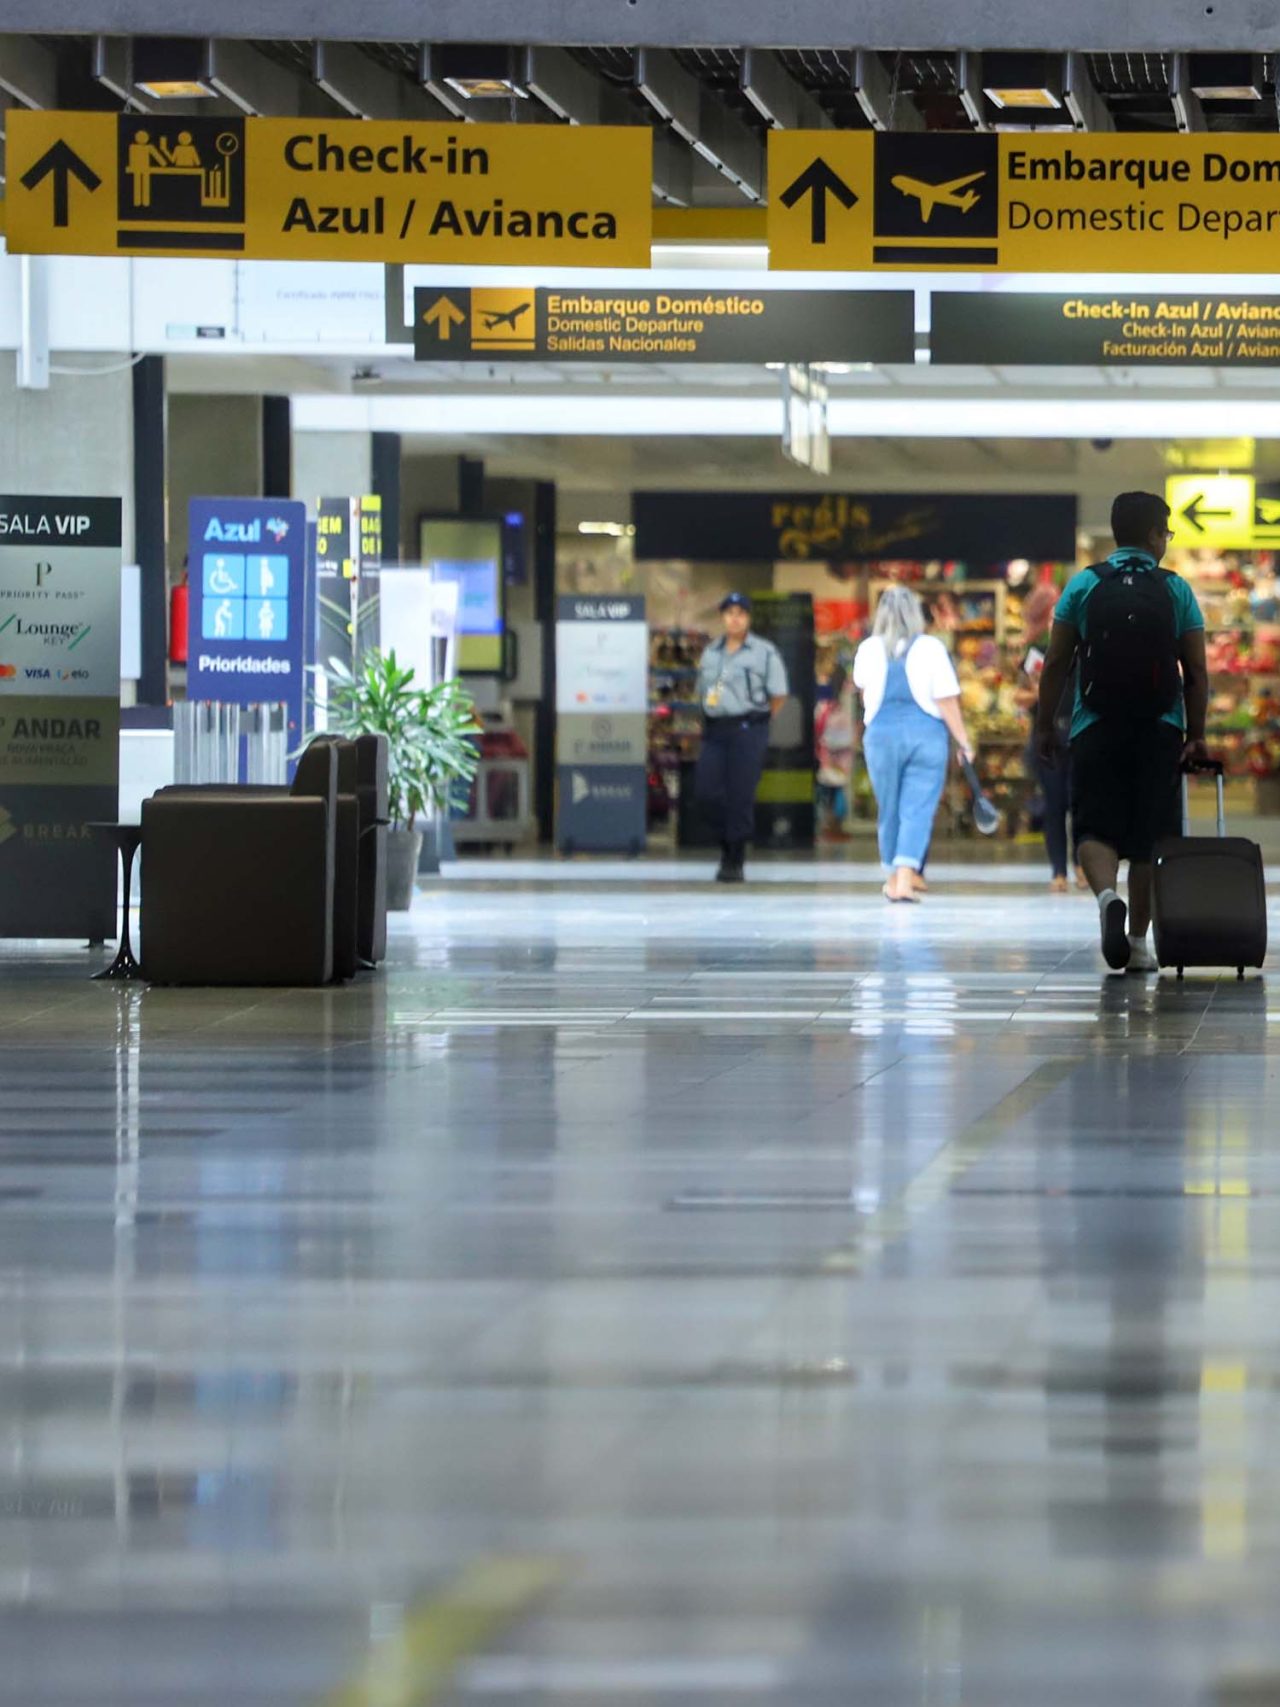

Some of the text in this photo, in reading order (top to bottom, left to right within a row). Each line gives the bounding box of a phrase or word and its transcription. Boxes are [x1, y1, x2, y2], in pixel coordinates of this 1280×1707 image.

[284, 134, 489, 175] Check-in
[1008, 150, 1190, 189] Embarque
[282, 197, 617, 240] Azul / Avianca
[1008, 201, 1164, 231] Domestic
[547, 295, 765, 317] Embarque Doméstico
[1154, 301, 1200, 320] Azul
[1203, 302, 1212, 322] /
[547, 316, 704, 336] Domestic Departure
[1190, 322, 1224, 339] Azul
[1225, 323, 1234, 340] /
[547, 336, 697, 353] Salidas Nacionales
[1103, 340, 1188, 358] Facturación
[1192, 341, 1224, 357] Azul
[1226, 342, 1235, 358] /
[0, 514, 91, 536] SALA VIP
[203, 516, 261, 543] Azul
[17, 619, 79, 639] Lounge
[25, 668, 51, 679] VISA
[199, 655, 291, 675] Prioridades
[13, 717, 102, 740] ANDAR
